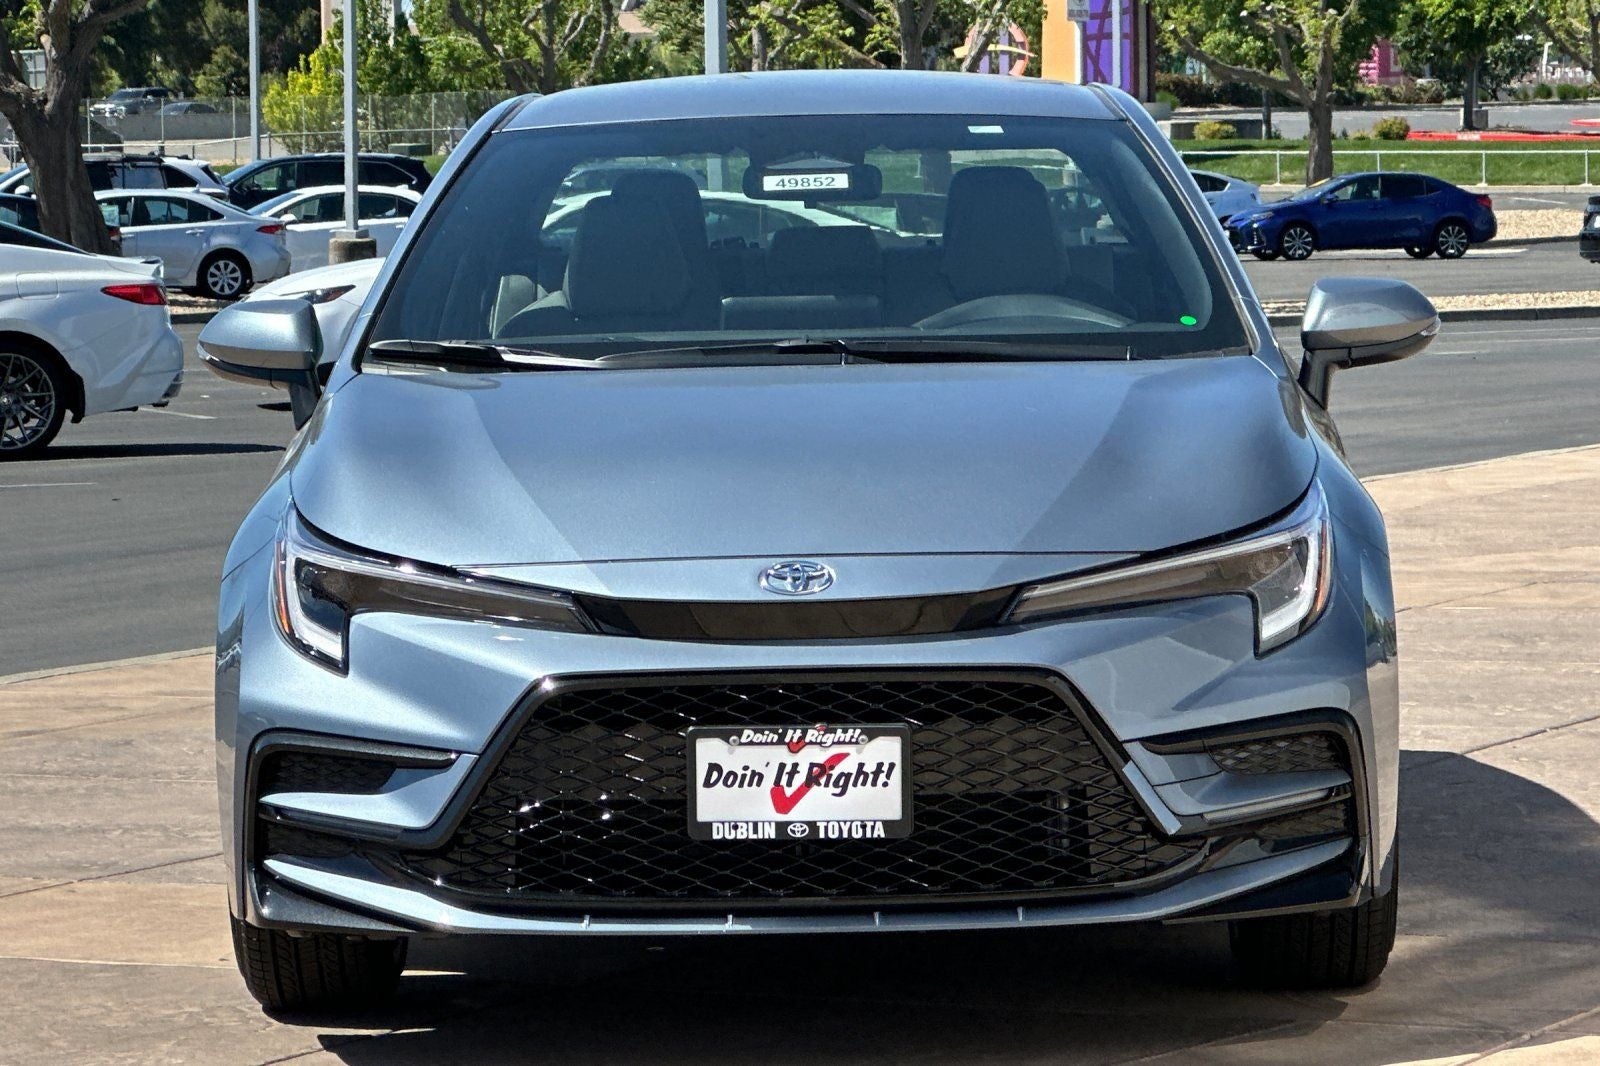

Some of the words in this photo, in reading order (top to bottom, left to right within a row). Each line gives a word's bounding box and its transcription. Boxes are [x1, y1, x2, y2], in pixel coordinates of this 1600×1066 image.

[775, 176, 836, 188] 49852
[740, 729, 781, 744] Doin'
[784, 729, 805, 743] It
[805, 729, 861, 747] Right!
[703, 762, 769, 788] Doin'
[773, 762, 799, 787] It
[805, 762, 896, 797] Right!
[712, 822, 775, 839] DUBLIN
[817, 822, 885, 839] TOYOTA
